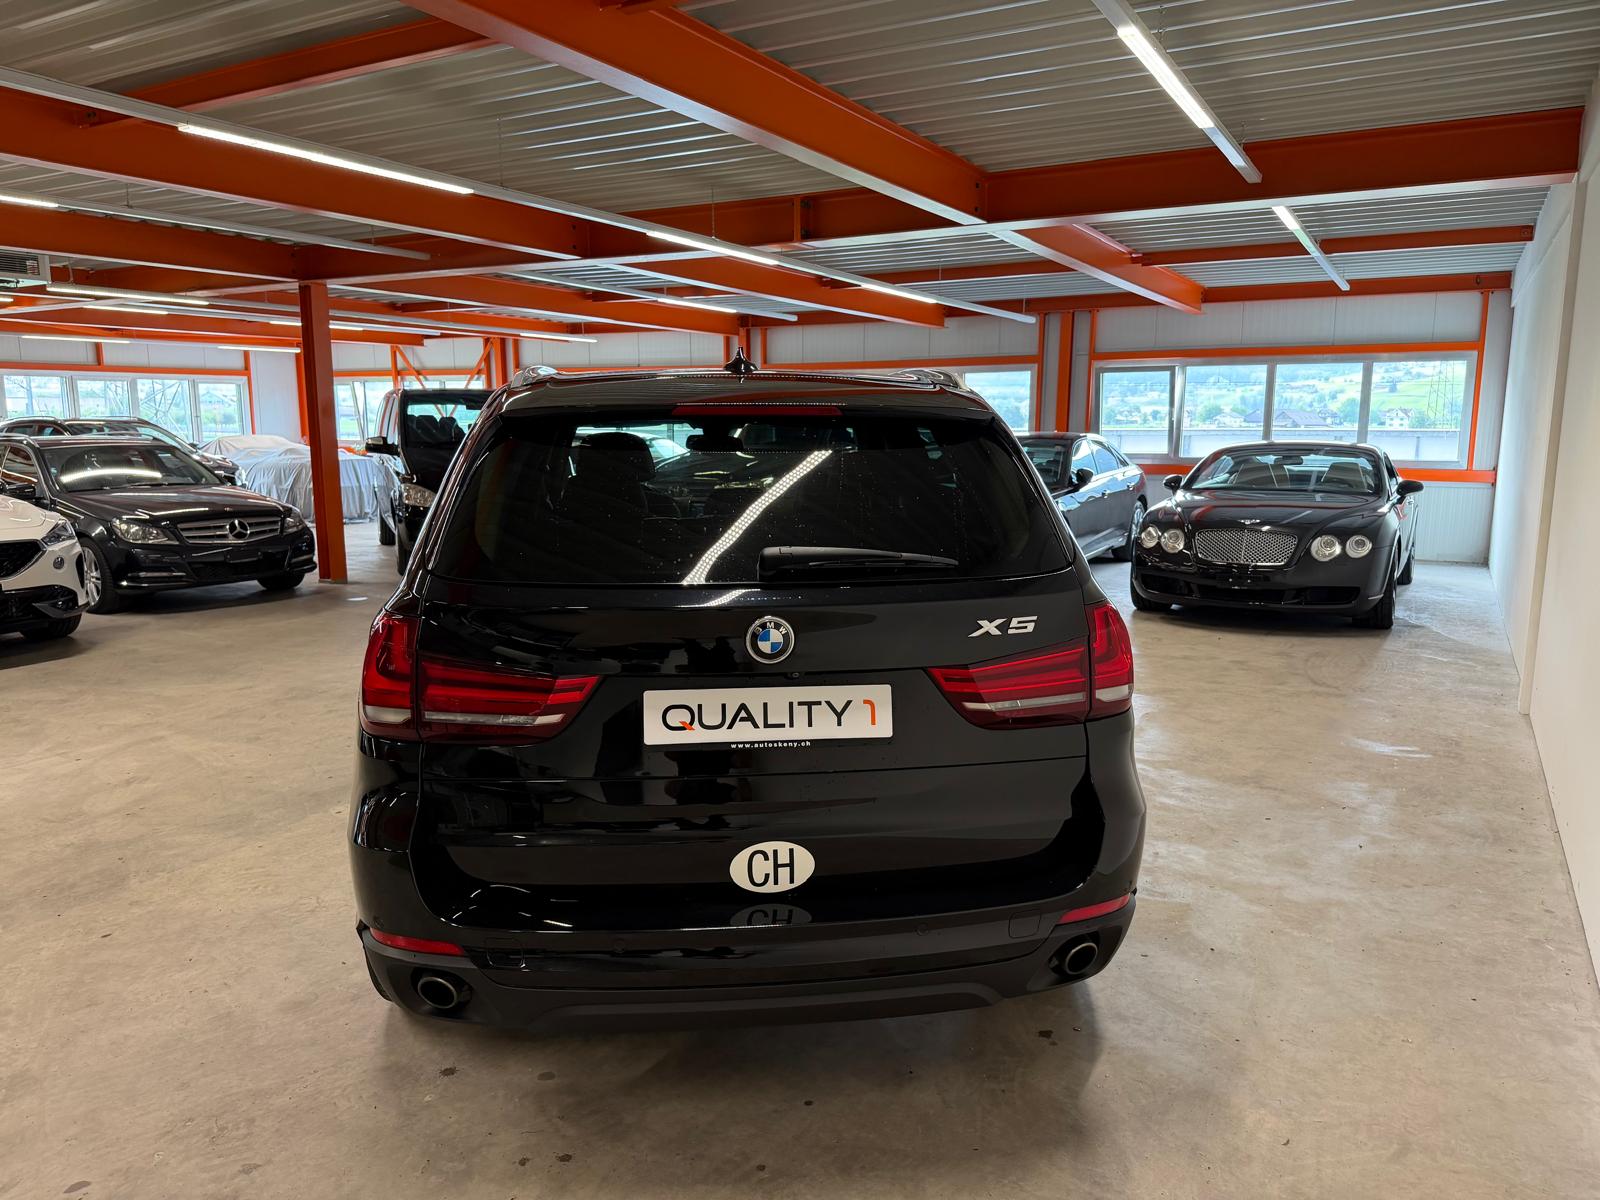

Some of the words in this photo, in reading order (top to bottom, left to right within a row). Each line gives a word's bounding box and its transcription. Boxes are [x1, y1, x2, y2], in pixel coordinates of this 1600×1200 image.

[753, 621, 788, 635] BMW
[967, 615, 1038, 638] X5
[661, 699, 853, 732] QUALITY
[863, 699, 877, 726] 1
[747, 847, 795, 888] CH
